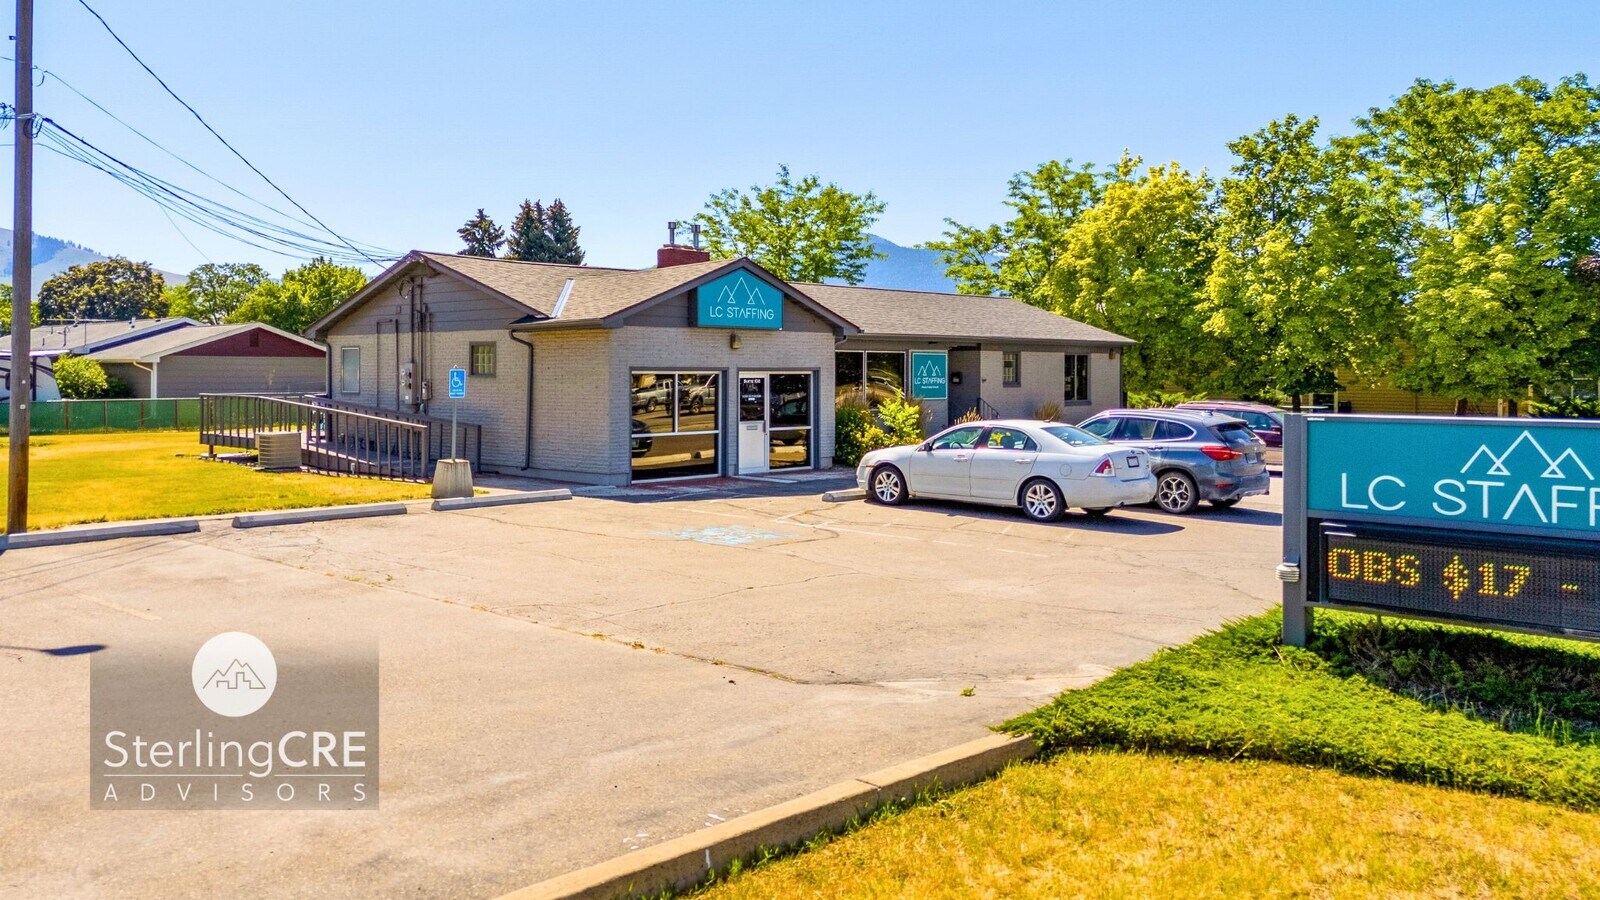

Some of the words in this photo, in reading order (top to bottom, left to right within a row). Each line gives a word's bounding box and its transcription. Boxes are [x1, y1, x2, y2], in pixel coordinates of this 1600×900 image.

[709, 306, 723, 318] LC
[726, 307, 774, 320] STAFFING
[1341, 472, 1406, 511] LC
[1443, 555, 1530, 600] $17
